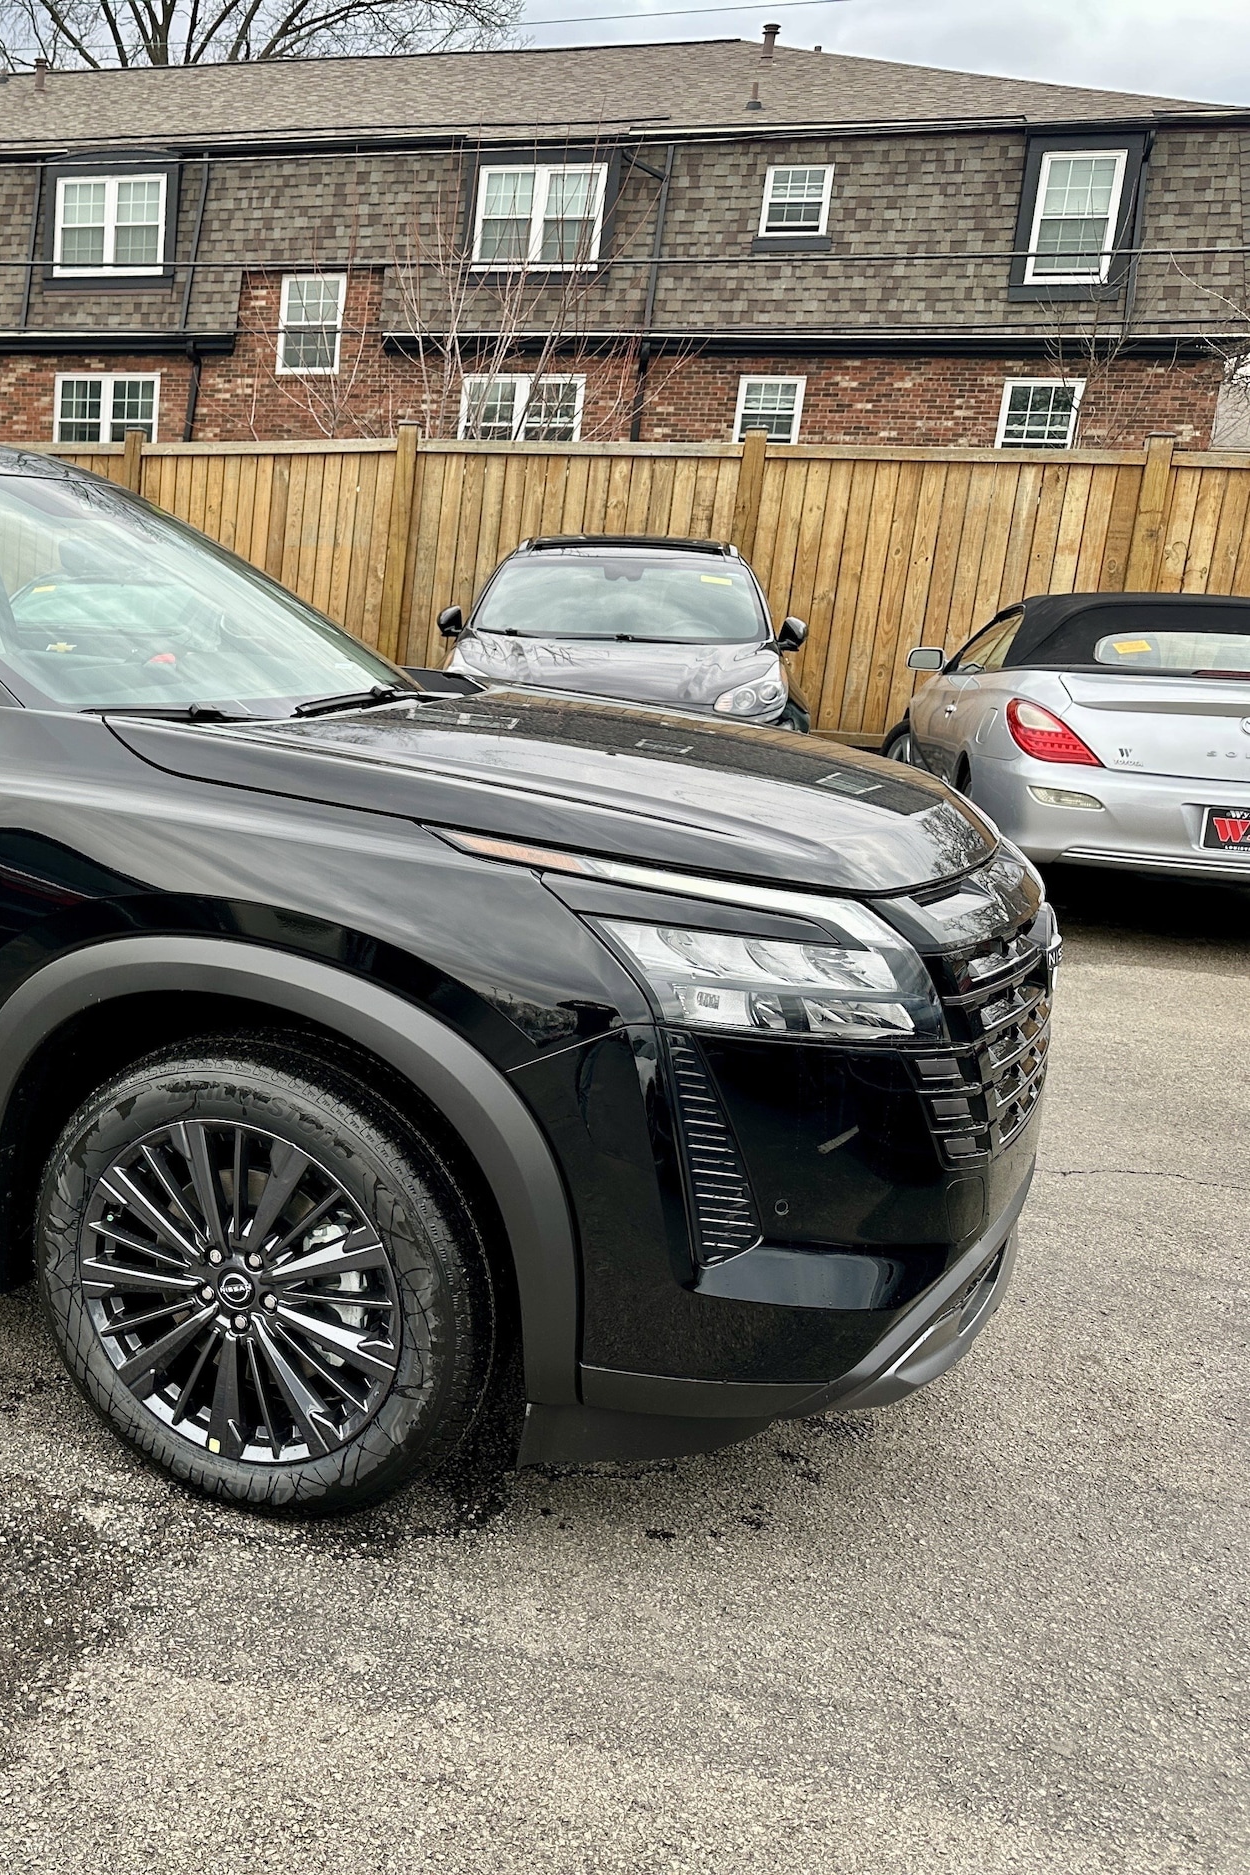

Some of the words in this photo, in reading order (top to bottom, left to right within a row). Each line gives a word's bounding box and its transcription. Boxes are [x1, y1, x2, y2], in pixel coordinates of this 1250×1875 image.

[1113, 759, 1144, 768] TOYOTA
[1230, 810, 1250, 819] Wy
[220, 1283, 252, 1294] NISSAN
